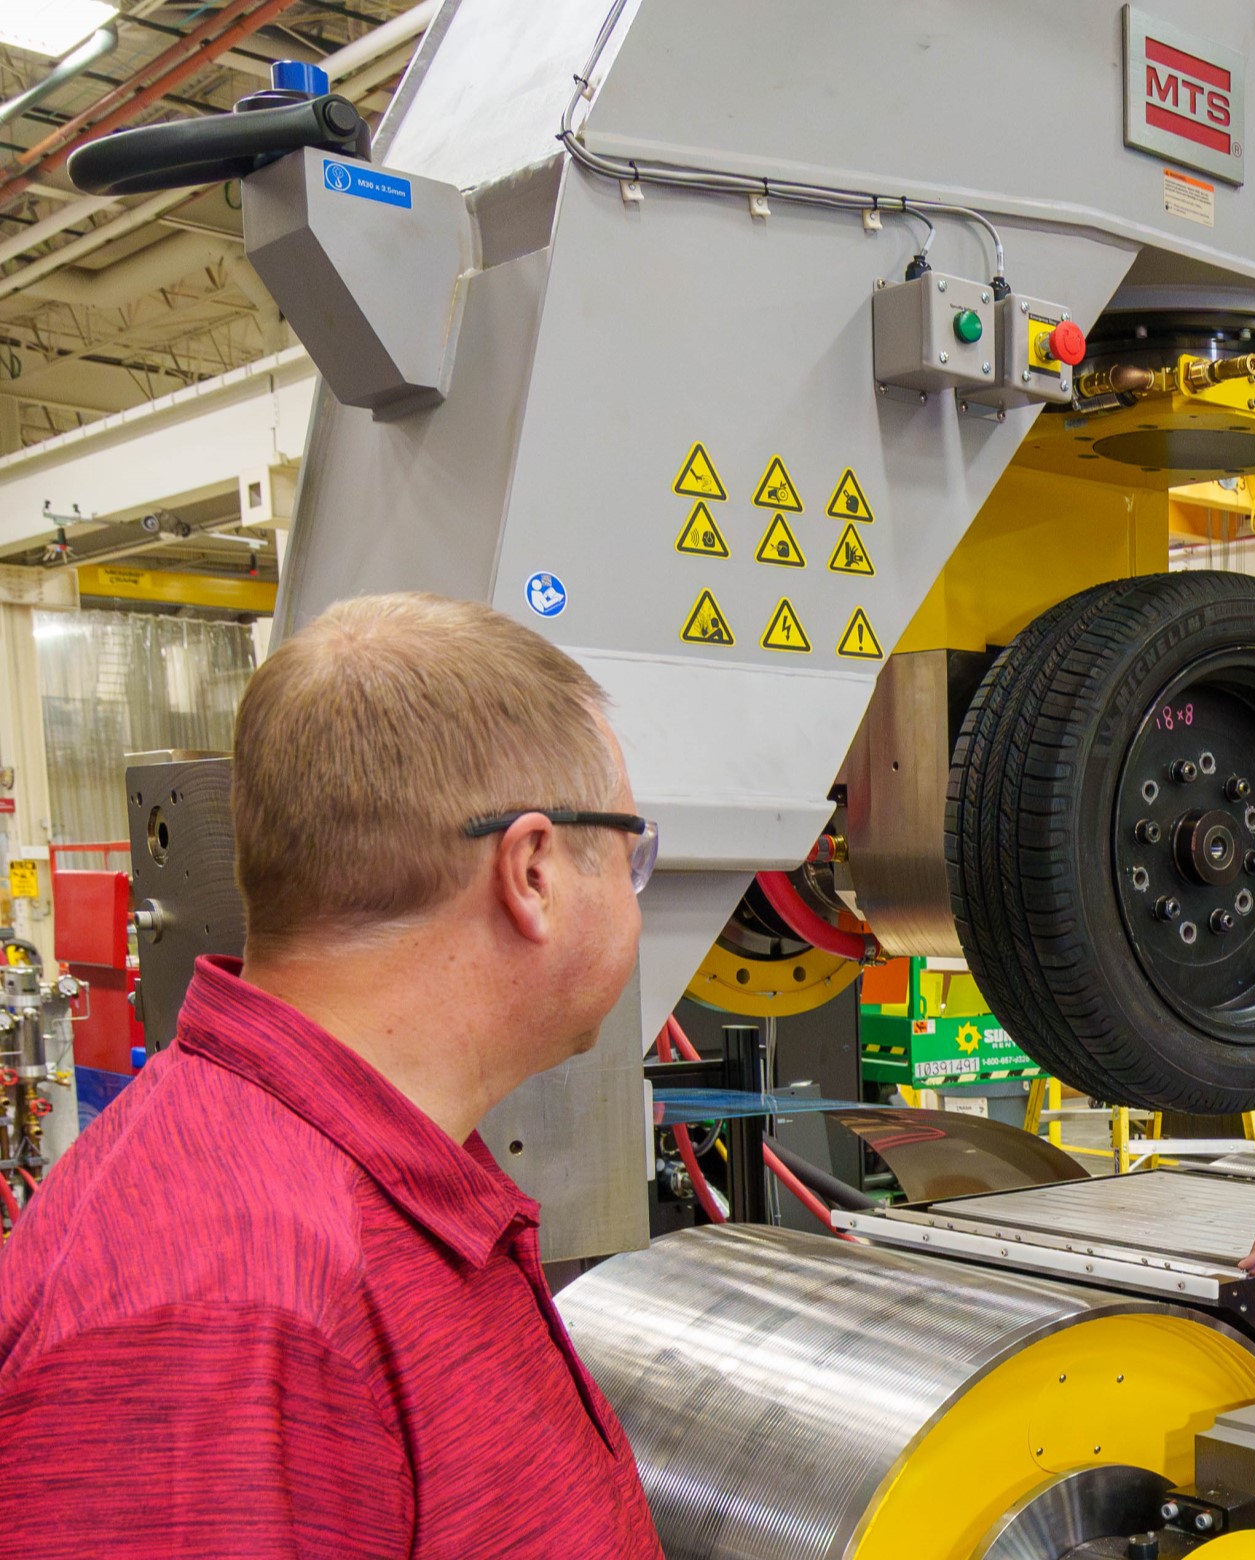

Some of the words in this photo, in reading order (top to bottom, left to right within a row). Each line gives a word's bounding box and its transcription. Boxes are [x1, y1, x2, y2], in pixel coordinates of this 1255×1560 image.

[1145, 64, 1231, 127] MTS
[357, 178, 374, 190] M30
[917, 1059, 978, 1077] 10391491
